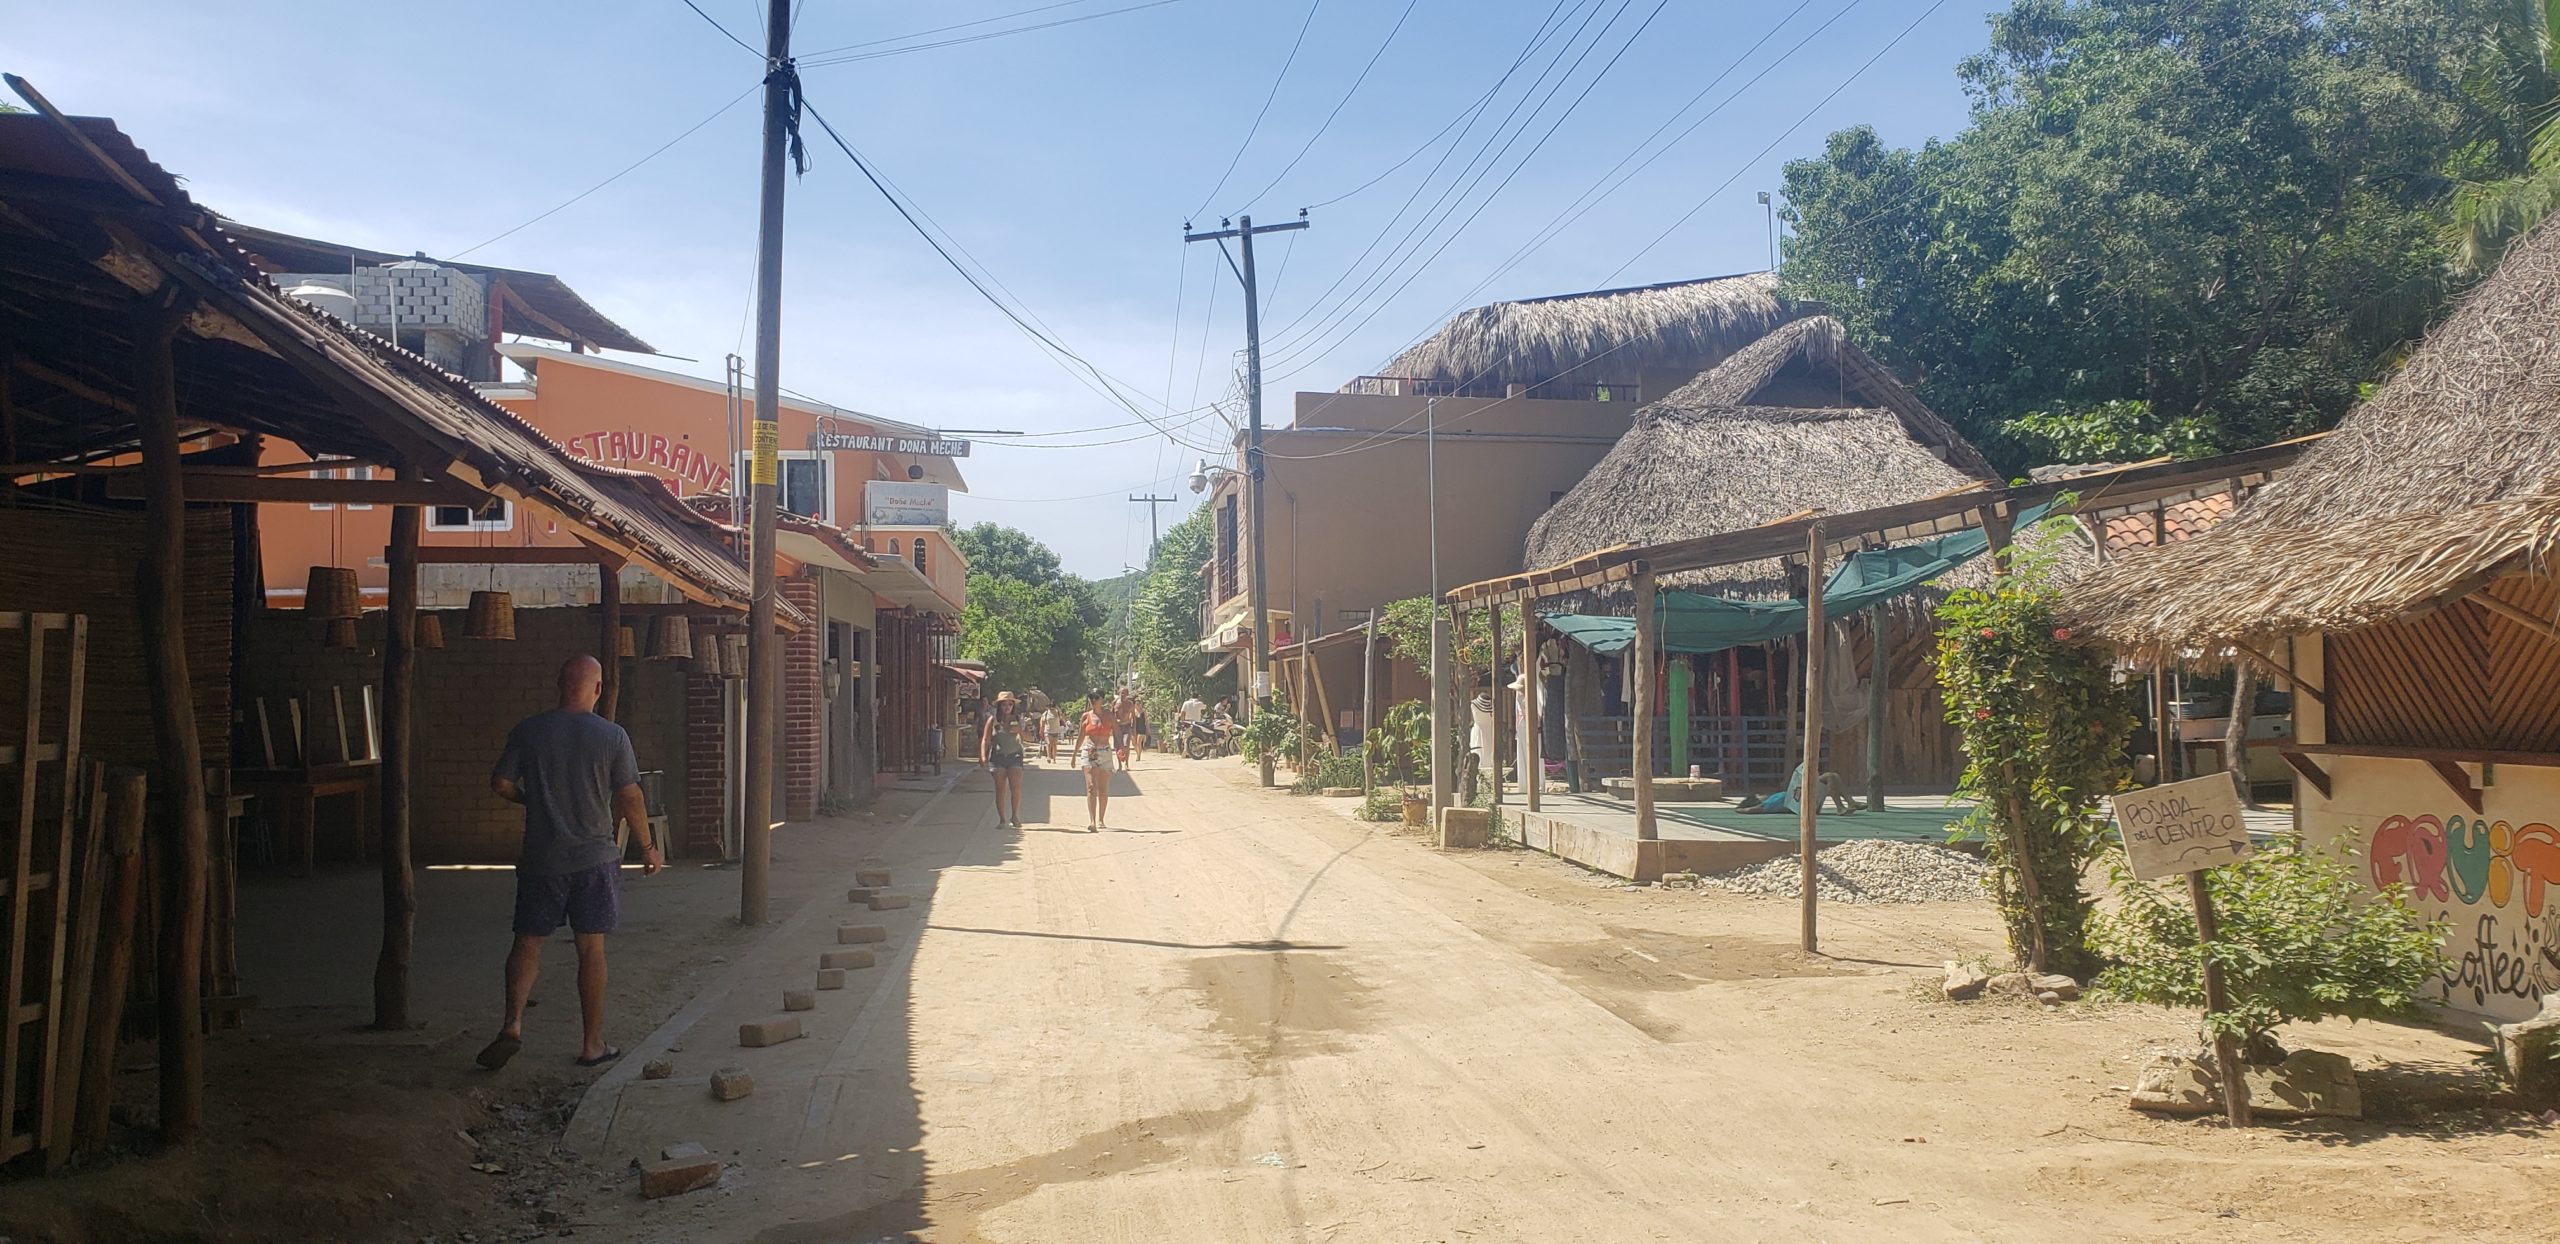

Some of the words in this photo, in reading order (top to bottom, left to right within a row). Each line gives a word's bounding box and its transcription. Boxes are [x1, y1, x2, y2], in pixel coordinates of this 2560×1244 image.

[816, 433, 895, 452] RESTAURANT
[931, 441, 964, 456] MECHE
[561, 431, 732, 492] STAURANT
[2125, 796, 2205, 827] POSADA
[2134, 828, 2155, 841] DEL
[2155, 814, 2236, 846] CENTRO
